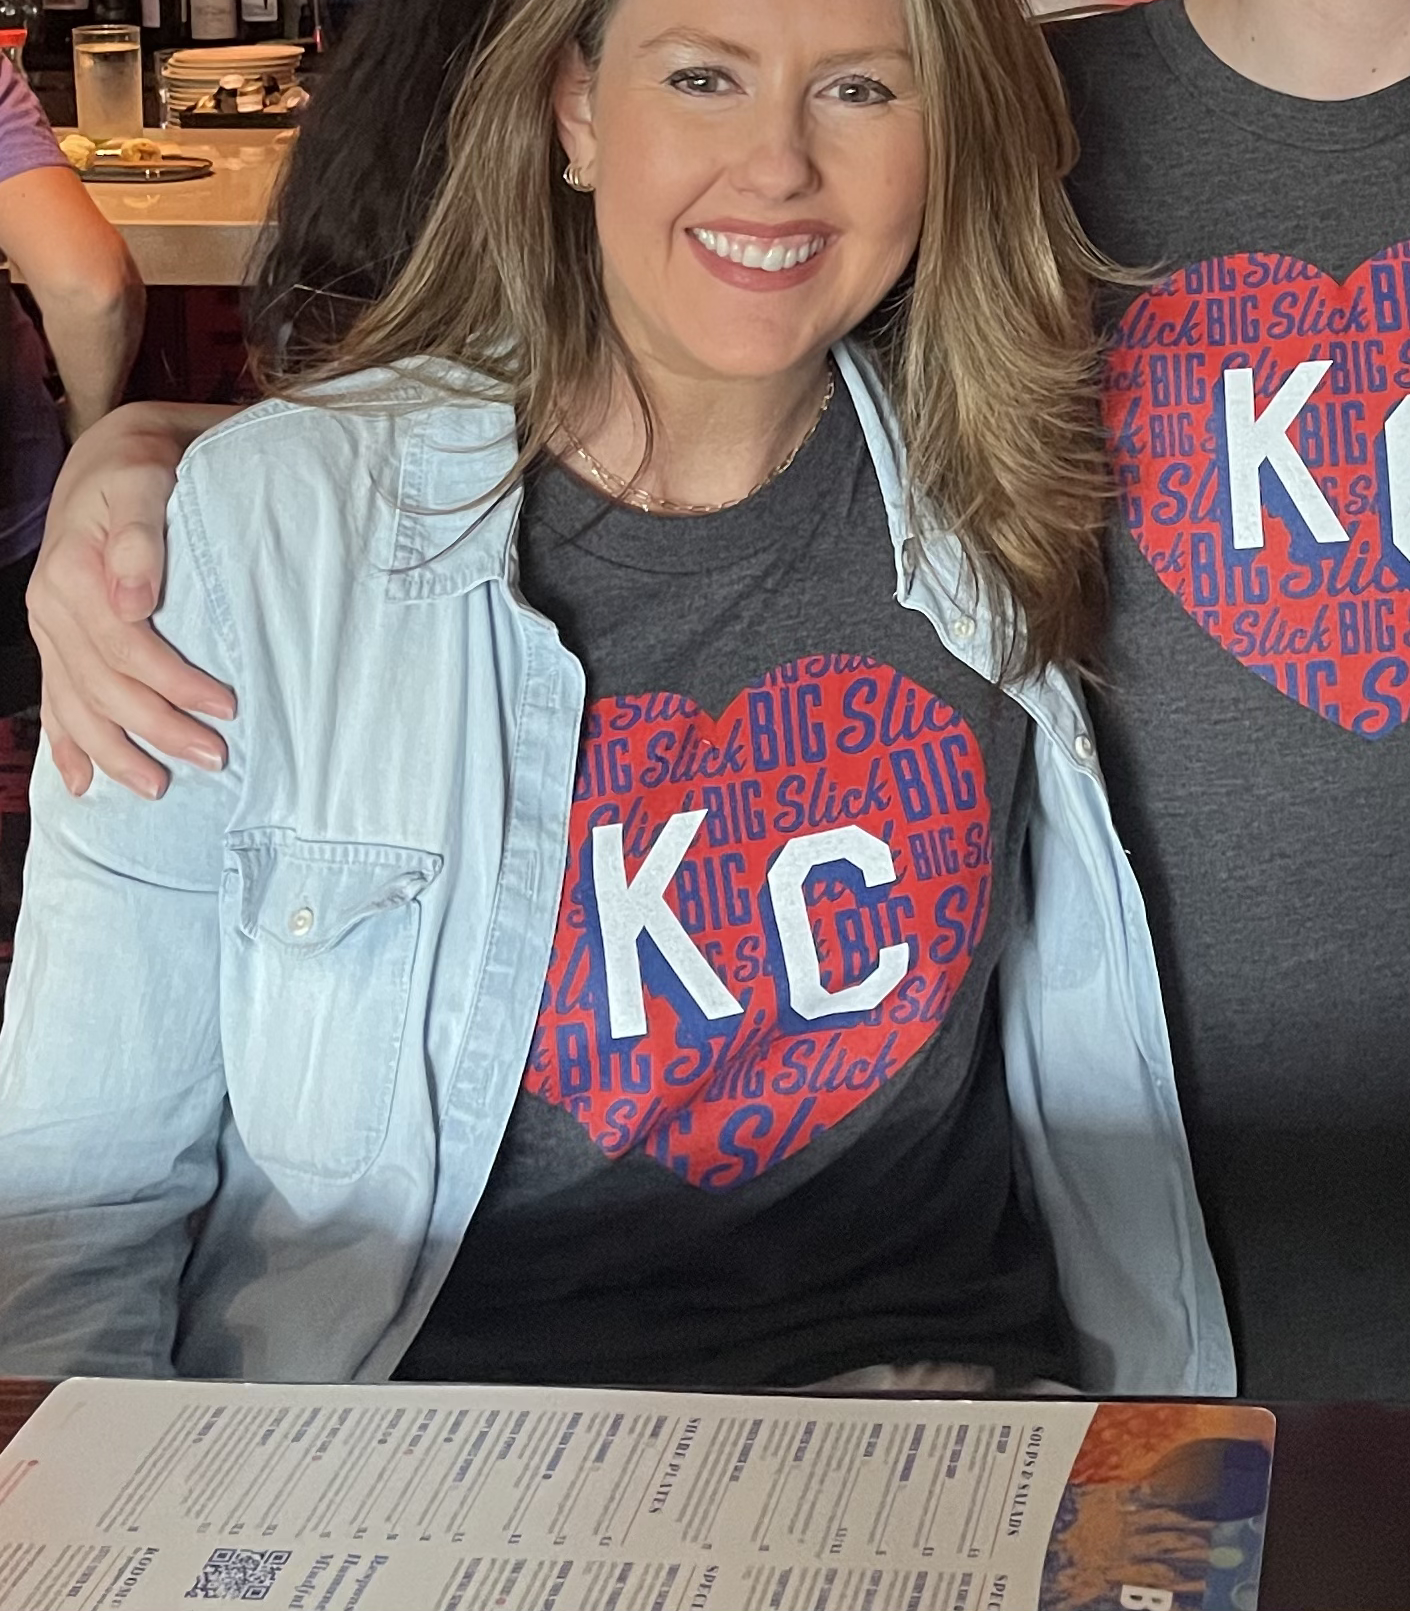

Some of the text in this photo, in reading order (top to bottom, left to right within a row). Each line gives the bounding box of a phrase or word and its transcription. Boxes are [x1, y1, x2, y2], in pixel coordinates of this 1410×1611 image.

[1114, 298, 1202, 349] lick
[1206, 294, 1261, 346] BIG
[1267, 286, 1370, 340] Slick
[1150, 352, 1206, 407] BIG
[1329, 340, 1388, 395] BIG
[1150, 412, 1196, 458] BIG
[1299, 400, 1368, 468] BIG
[1228, 604, 1332, 657] Slick
[1338, 598, 1396, 655] BIG
[639, 718, 748, 789] Slick
[748, 683, 827, 772] BIG
[837, 671, 963, 754] Slic
[702, 780, 766, 848] BIG
[774, 757, 892, 833] Slick
[889, 733, 977, 823] BIG
[675, 826, 960, 935] BIG BIG
[771, 1031, 897, 1095] Slick
[648, 1417, 701, 1513] SHARE PLATES
[1023, 1426, 1044, 1468] SOUPS
[1007, 1483, 1030, 1537] SALADS
